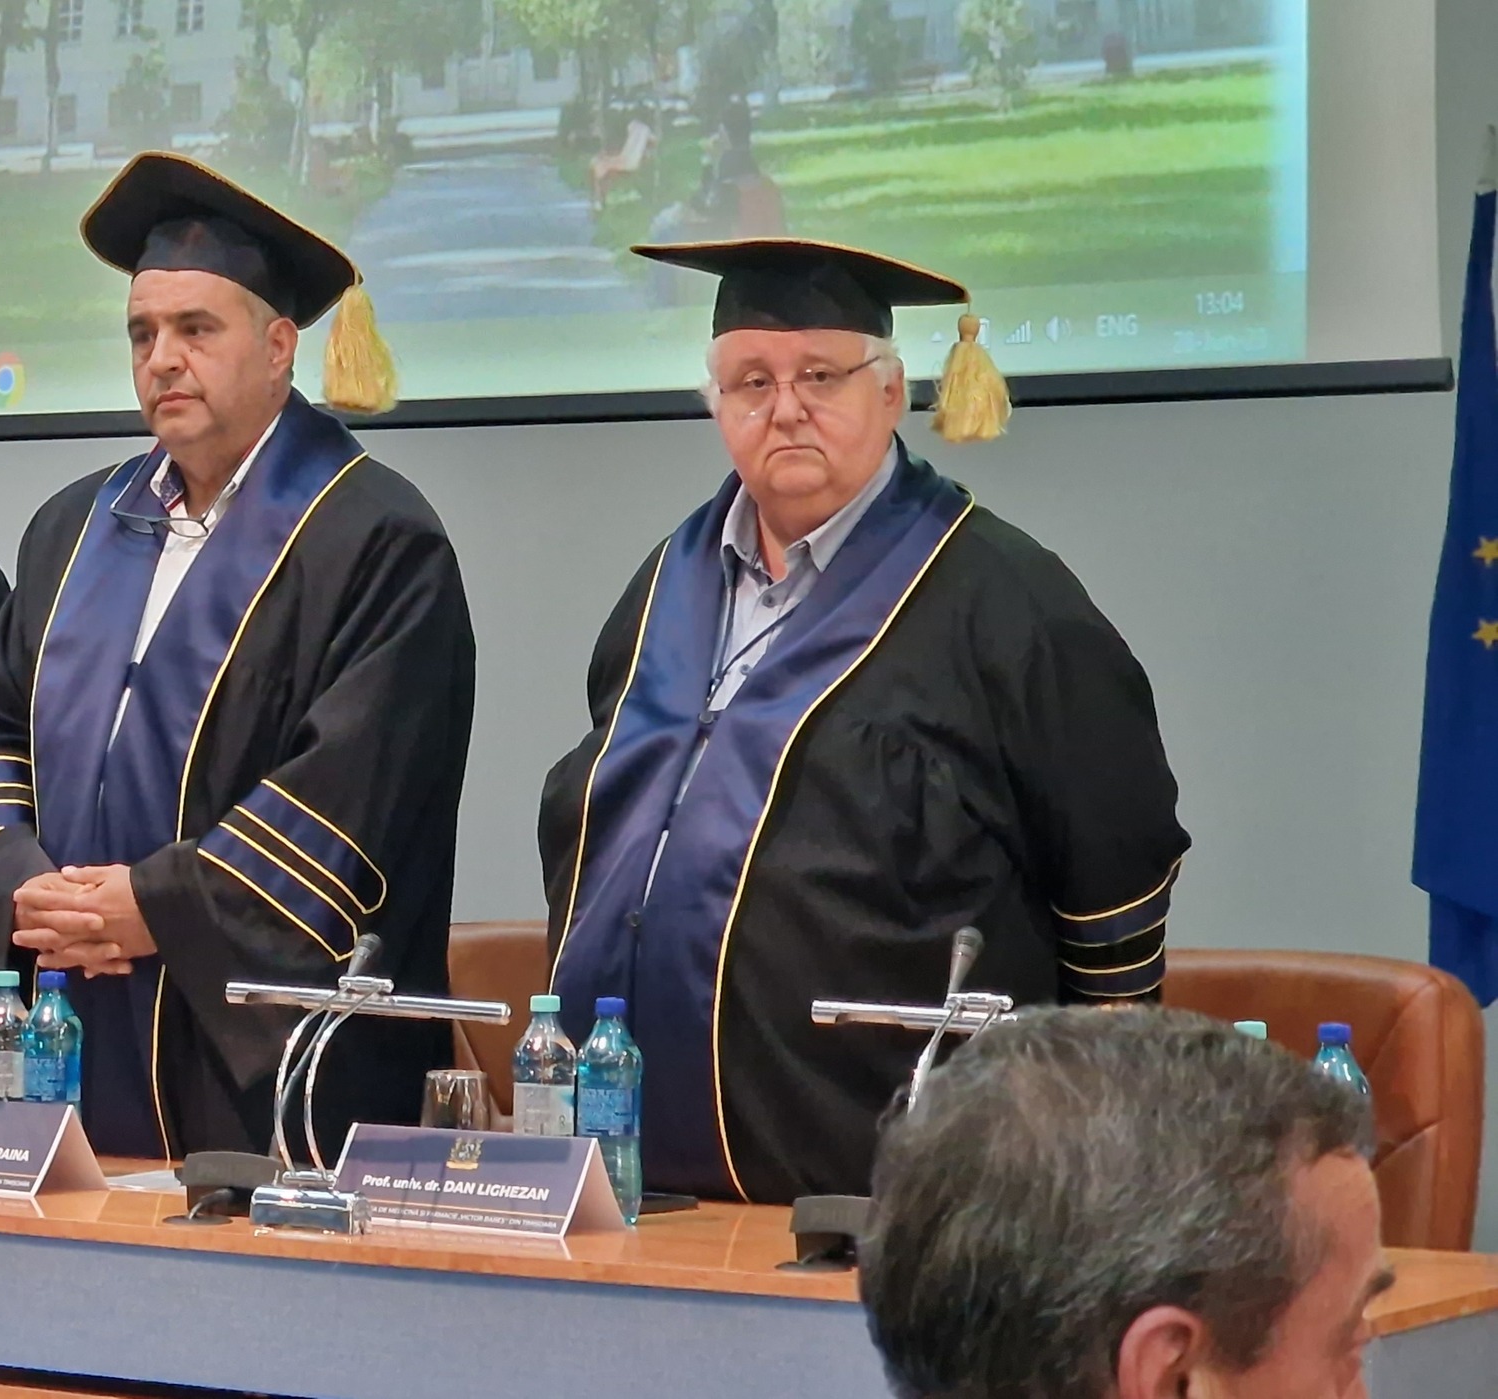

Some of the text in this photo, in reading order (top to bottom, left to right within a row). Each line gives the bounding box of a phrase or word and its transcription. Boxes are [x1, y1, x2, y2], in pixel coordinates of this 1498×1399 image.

[1195, 291, 1244, 315] 13:04
[1096, 314, 1139, 337] ENG
[362, 1174, 550, 1201] Prof. univ. dr. DAN LIGHEZAN
